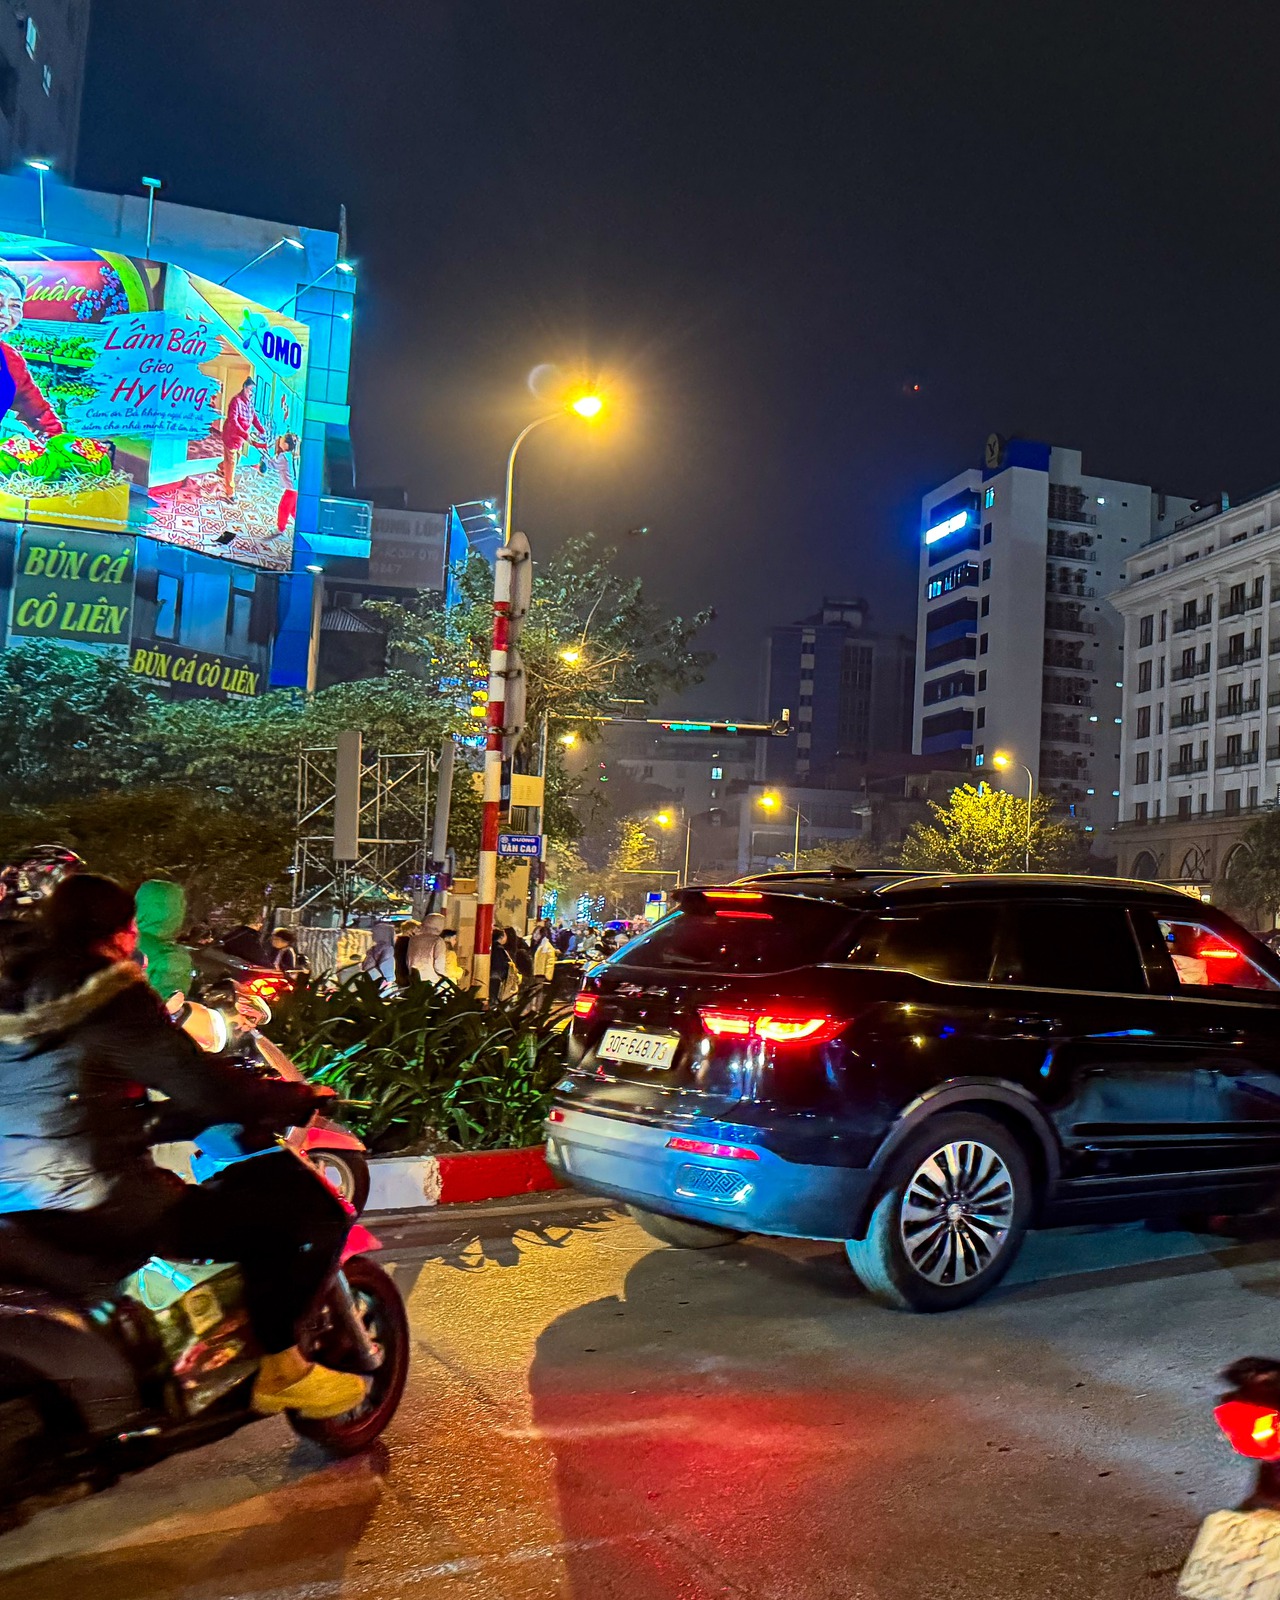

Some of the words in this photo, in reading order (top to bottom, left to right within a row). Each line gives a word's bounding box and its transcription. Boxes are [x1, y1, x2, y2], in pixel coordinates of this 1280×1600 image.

[104, 318, 164, 350] Lấm
[167, 324, 208, 356] Bẩn
[262, 331, 302, 369] OMO
[139, 358, 174, 374] Gieo
[110, 377, 157, 408] Hy
[161, 377, 208, 411] Vọng
[104, 420, 119, 430] cho
[23, 541, 88, 580] BÚN
[88, 548, 131, 584] CÁ
[16, 591, 58, 628] CÔ
[60, 596, 129, 634] LIÊN
[132, 645, 172, 678] BÚN
[171, 653, 197, 683] CÁ
[196, 658, 221, 688] CÔ
[221, 664, 260, 696] LIÊN
[520, 845, 537, 853] CAO
